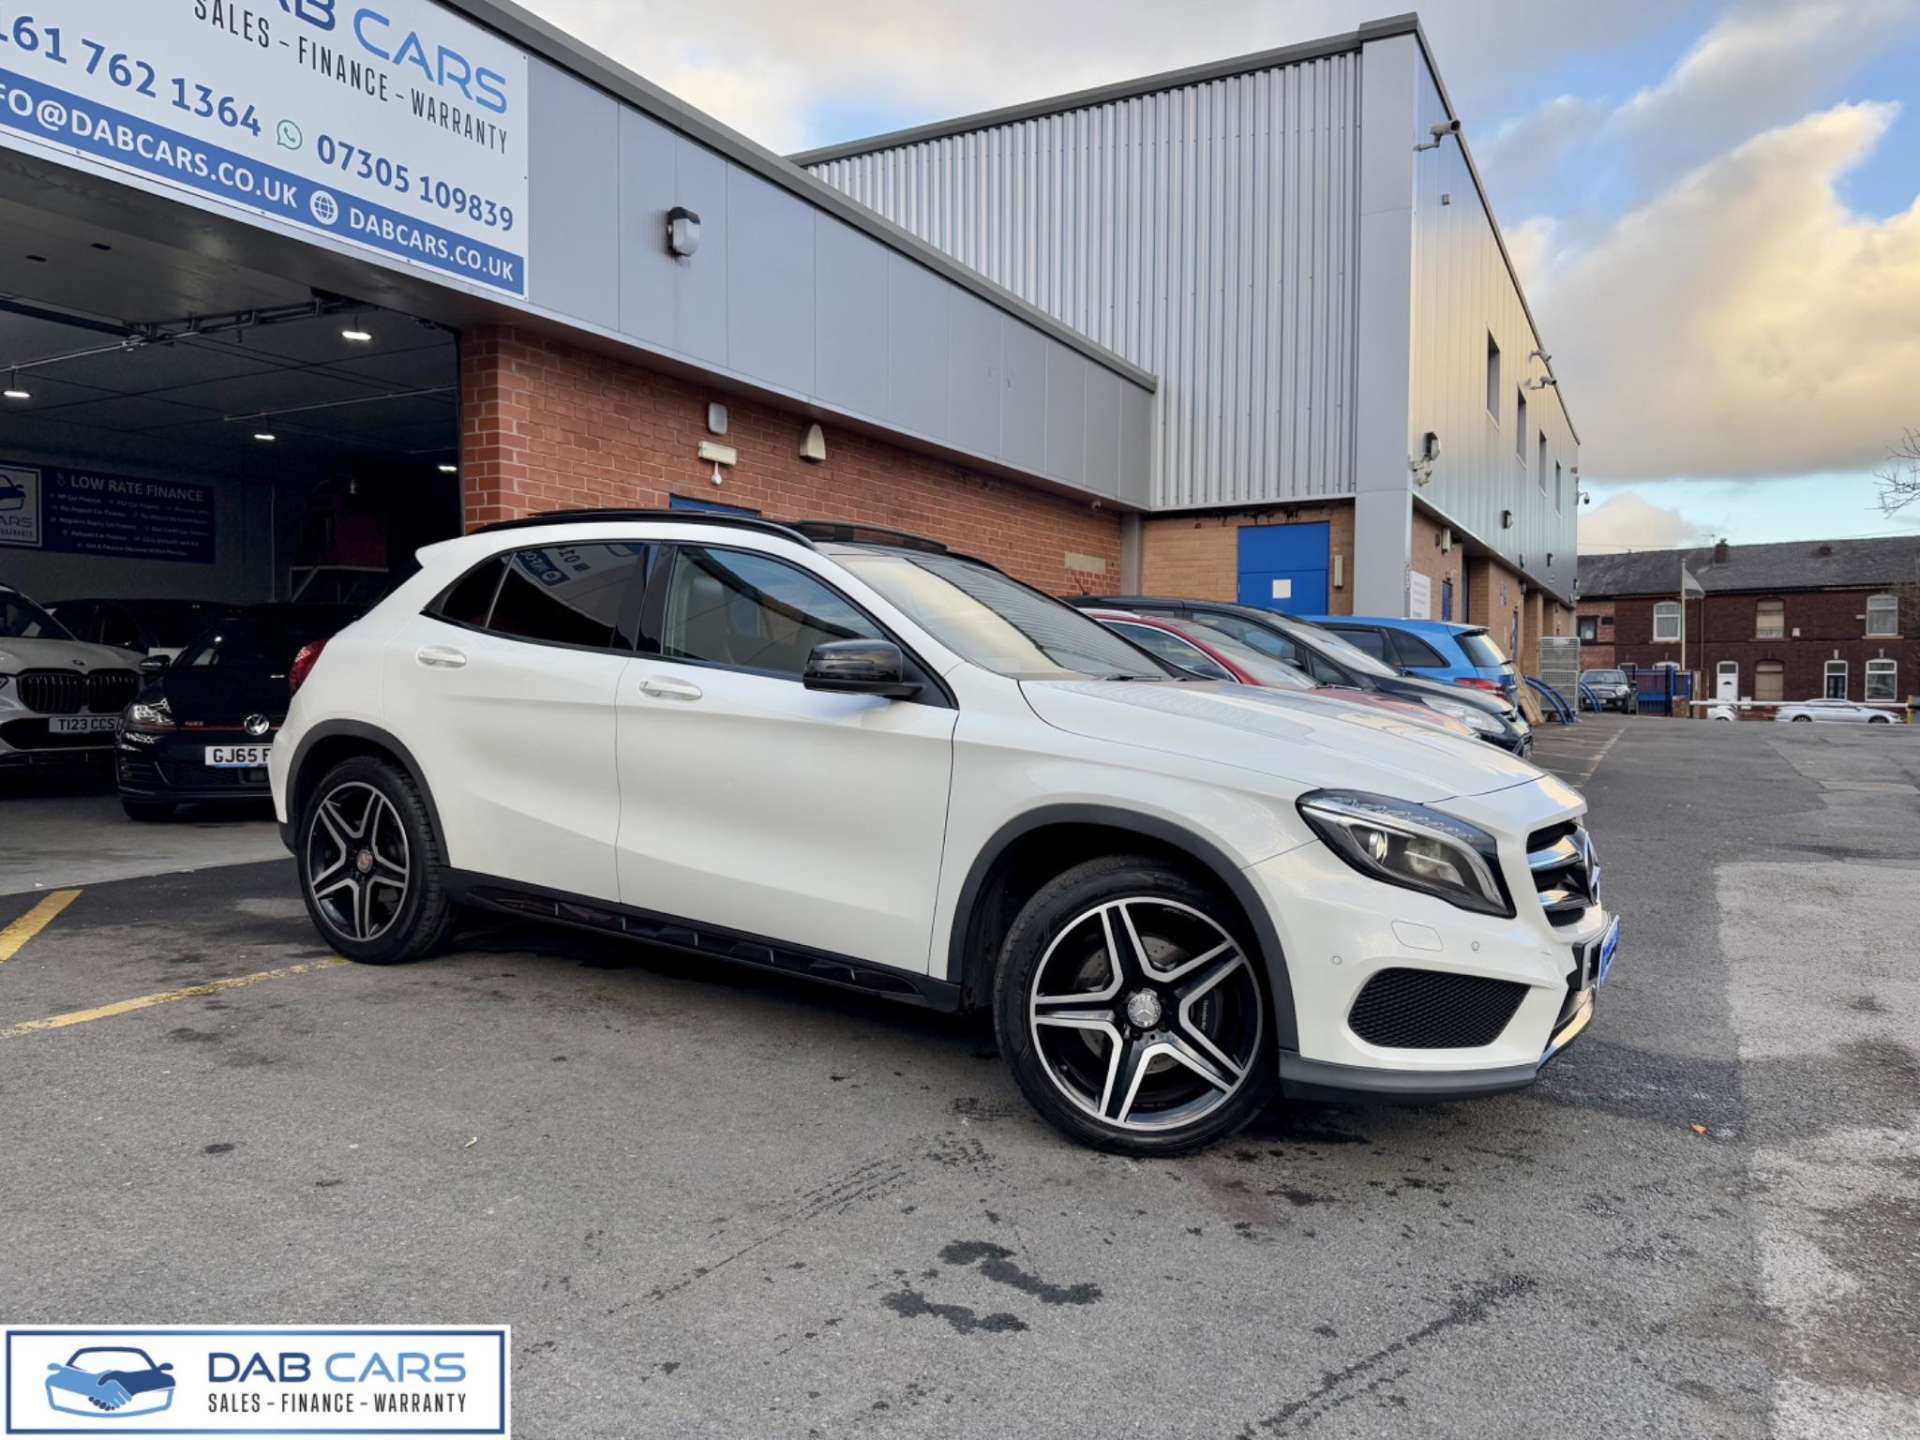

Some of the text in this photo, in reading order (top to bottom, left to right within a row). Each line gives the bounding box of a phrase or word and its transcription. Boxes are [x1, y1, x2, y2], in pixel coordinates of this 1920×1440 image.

[194, 0, 270, 48] SALES
[298, 36, 388, 102] FINANCE
[410, 87, 508, 154] WARRANTY
[353, 8, 507, 114] CARS
[0, 15, 513, 231] 61 762 1364 07305 109839
[350, 207, 513, 281] DABCARS.CO.UK
[71, 474, 204, 502] LOW RATE FINANCE
[213, 748, 257, 763] GJ65
